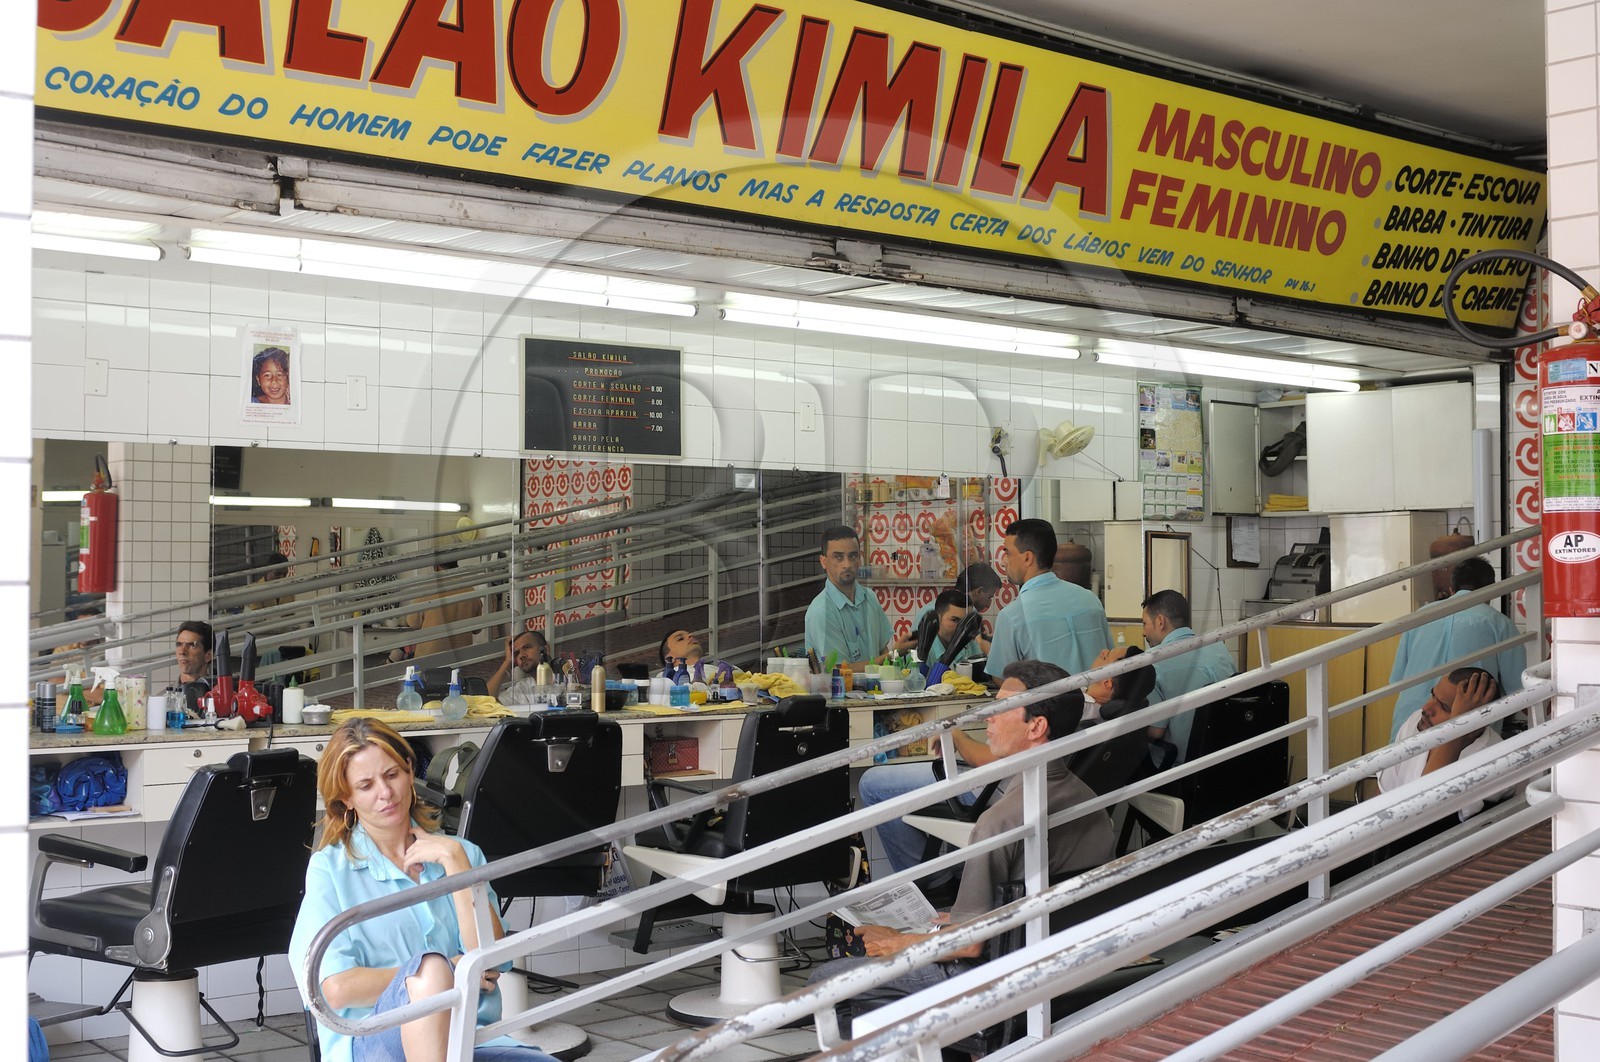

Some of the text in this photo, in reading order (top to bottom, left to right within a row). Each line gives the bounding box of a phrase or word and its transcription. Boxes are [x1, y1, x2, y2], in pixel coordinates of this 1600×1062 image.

[657, 0, 1109, 216] KIMILA
[1138, 103, 1380, 197] MASCULINO
[44, 66, 201, 111] CORAÇÃO
[218, 93, 269, 120] DO
[290, 105, 412, 142] HOMEM
[429, 125, 507, 156] PODE
[522, 143, 611, 174] FAZER
[623, 160, 727, 193] PLANOS
[739, 178, 799, 205] MAS
[805, 189, 823, 207] A
[834, 193, 940, 226] RESPOSTA
[950, 212, 1009, 238] CERTA
[1017, 225, 1056, 246] DOS
[1063, 231, 1131, 260] LÁBIOS
[1139, 246, 1173, 267] VEM
[1181, 255, 1205, 272] DO
[1211, 259, 1273, 285] SENHOR
[1120, 169, 1347, 256] FEMININO
[1384, 205, 1534, 242] BARBA TINTURA
[1372, 242, 1440, 273] BANHO
[1440, 247, 1470, 273] DE
[1362, 278, 1429, 309] BANHO
[1461, 285, 1527, 312] CREME
[572, 380, 597, 388] CORTE
[572, 393, 597, 402] CORTE
[600, 395, 635, 404] FEMININO
[572, 407, 602, 415] ESCOVA
[572, 420, 598, 428] BARBA
[572, 434, 620, 443] GRATO PELA
[572, 444, 625, 452] PREFERENCIA
[1563, 534, 1584, 548] AP
[1554, 547, 1597, 555] EXTINTORES
